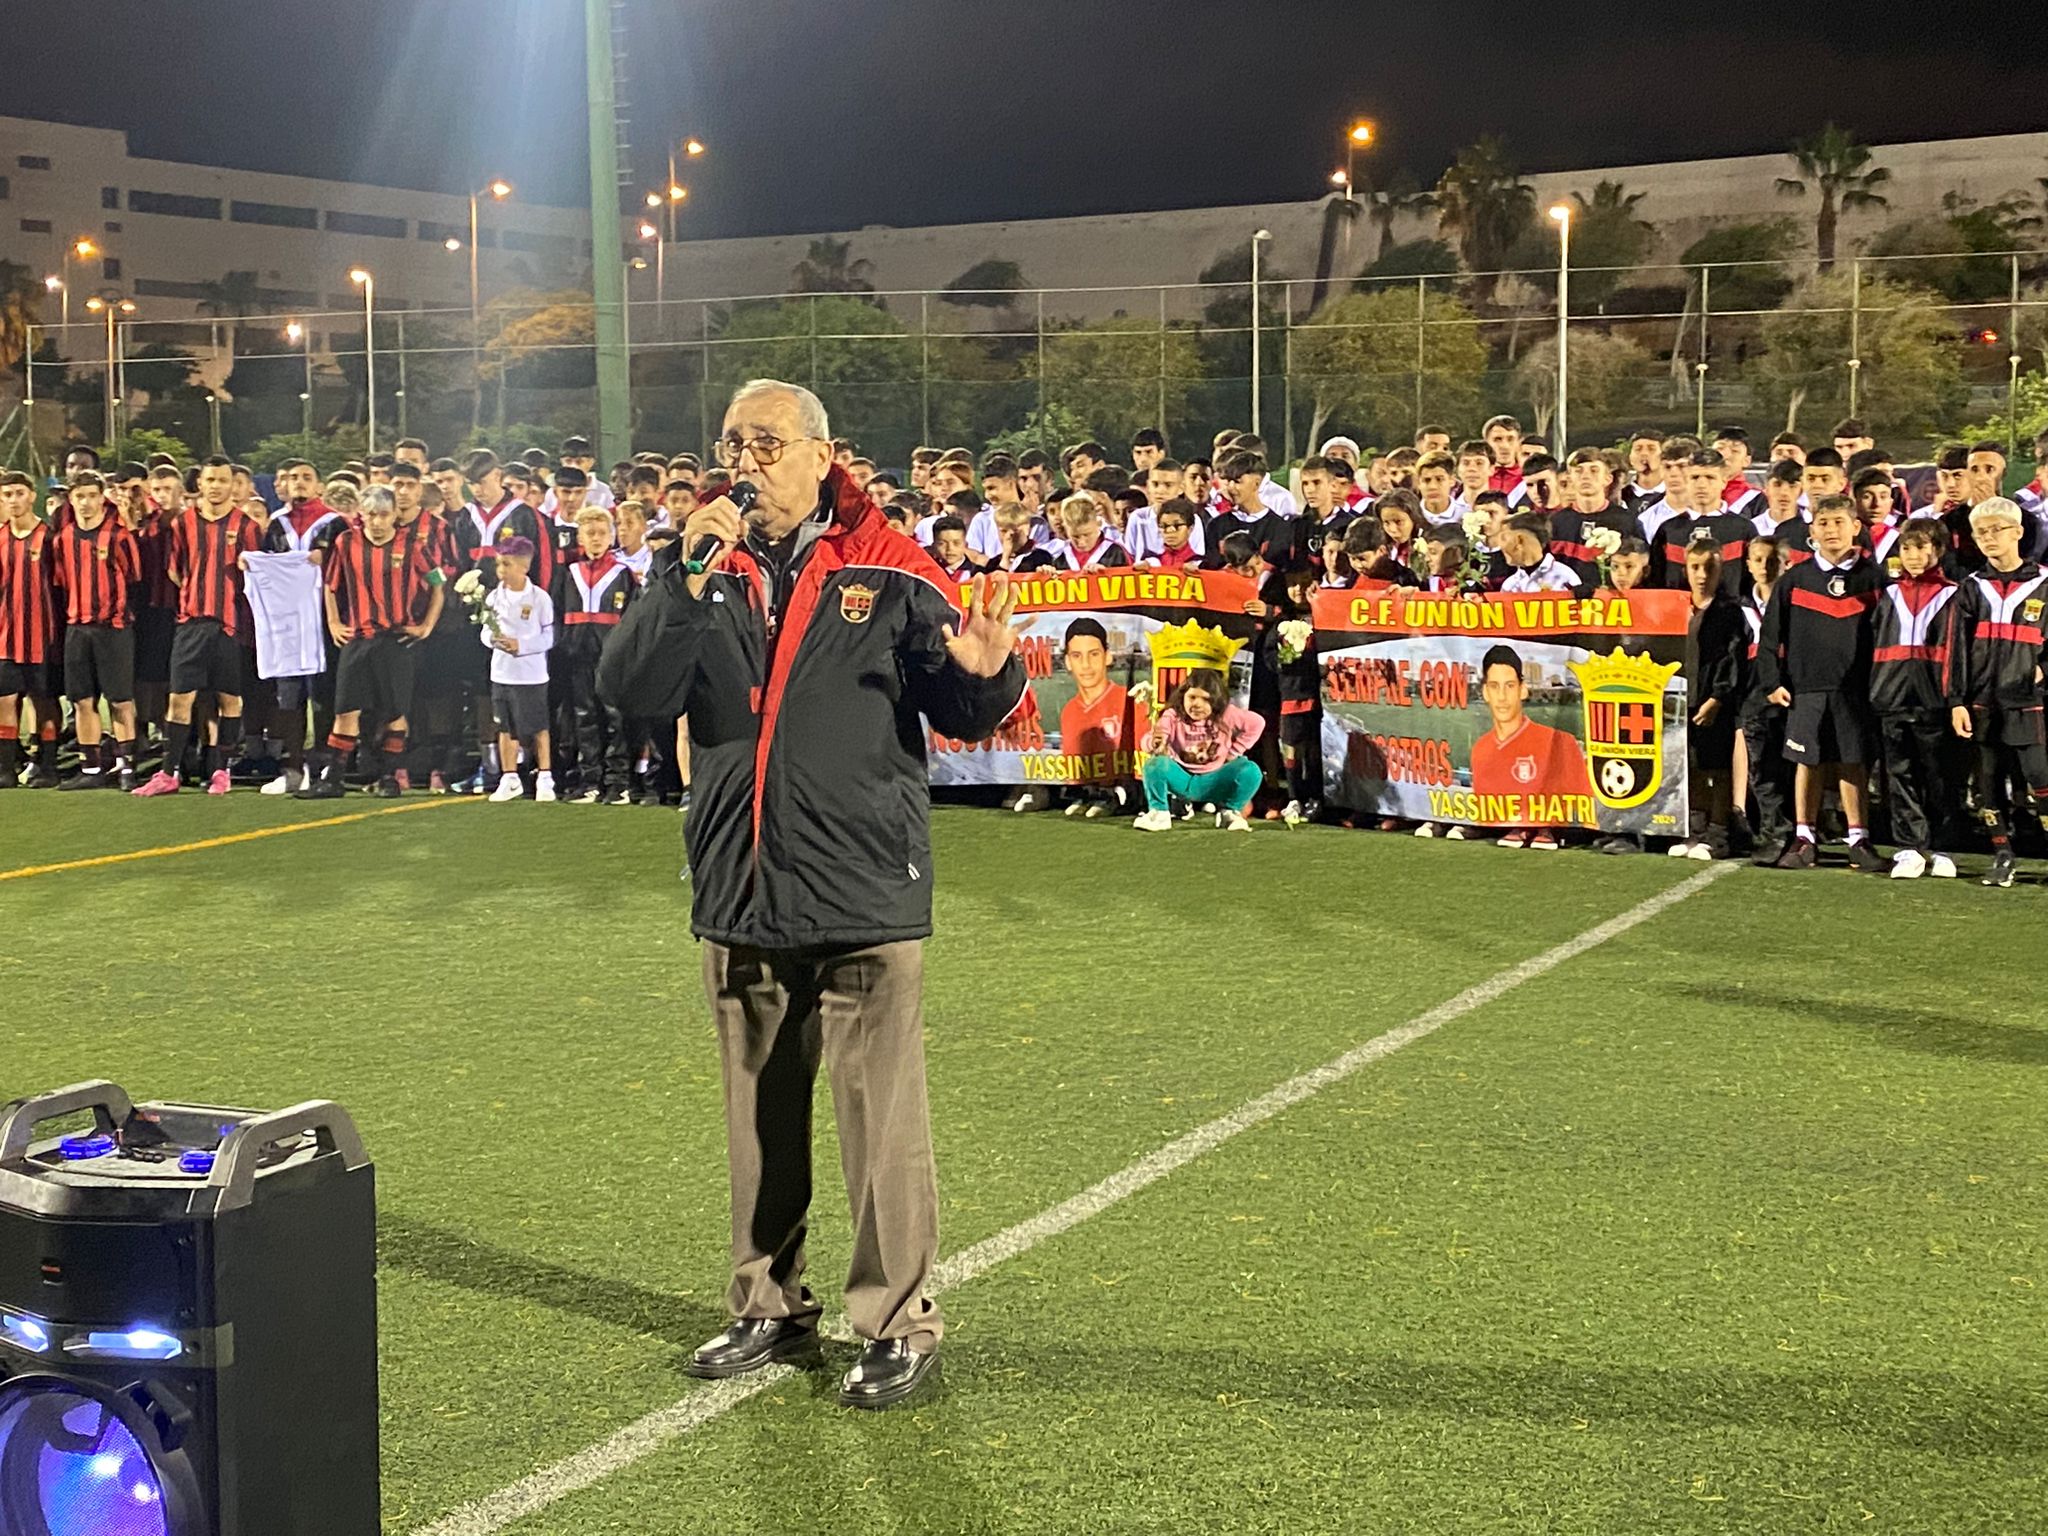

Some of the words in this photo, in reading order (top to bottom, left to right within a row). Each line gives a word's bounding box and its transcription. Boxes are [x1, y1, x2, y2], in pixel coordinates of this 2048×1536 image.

[1099, 574, 1206, 602] VIERA
[1350, 598, 1396, 626] C.F.
[1514, 599, 1633, 628] VIERA
[1420, 660, 1468, 709] CON
[1020, 753, 1106, 780] YASSINE
[1428, 790, 1523, 822] YASSINE
[1529, 794, 1597, 825] HATRI
